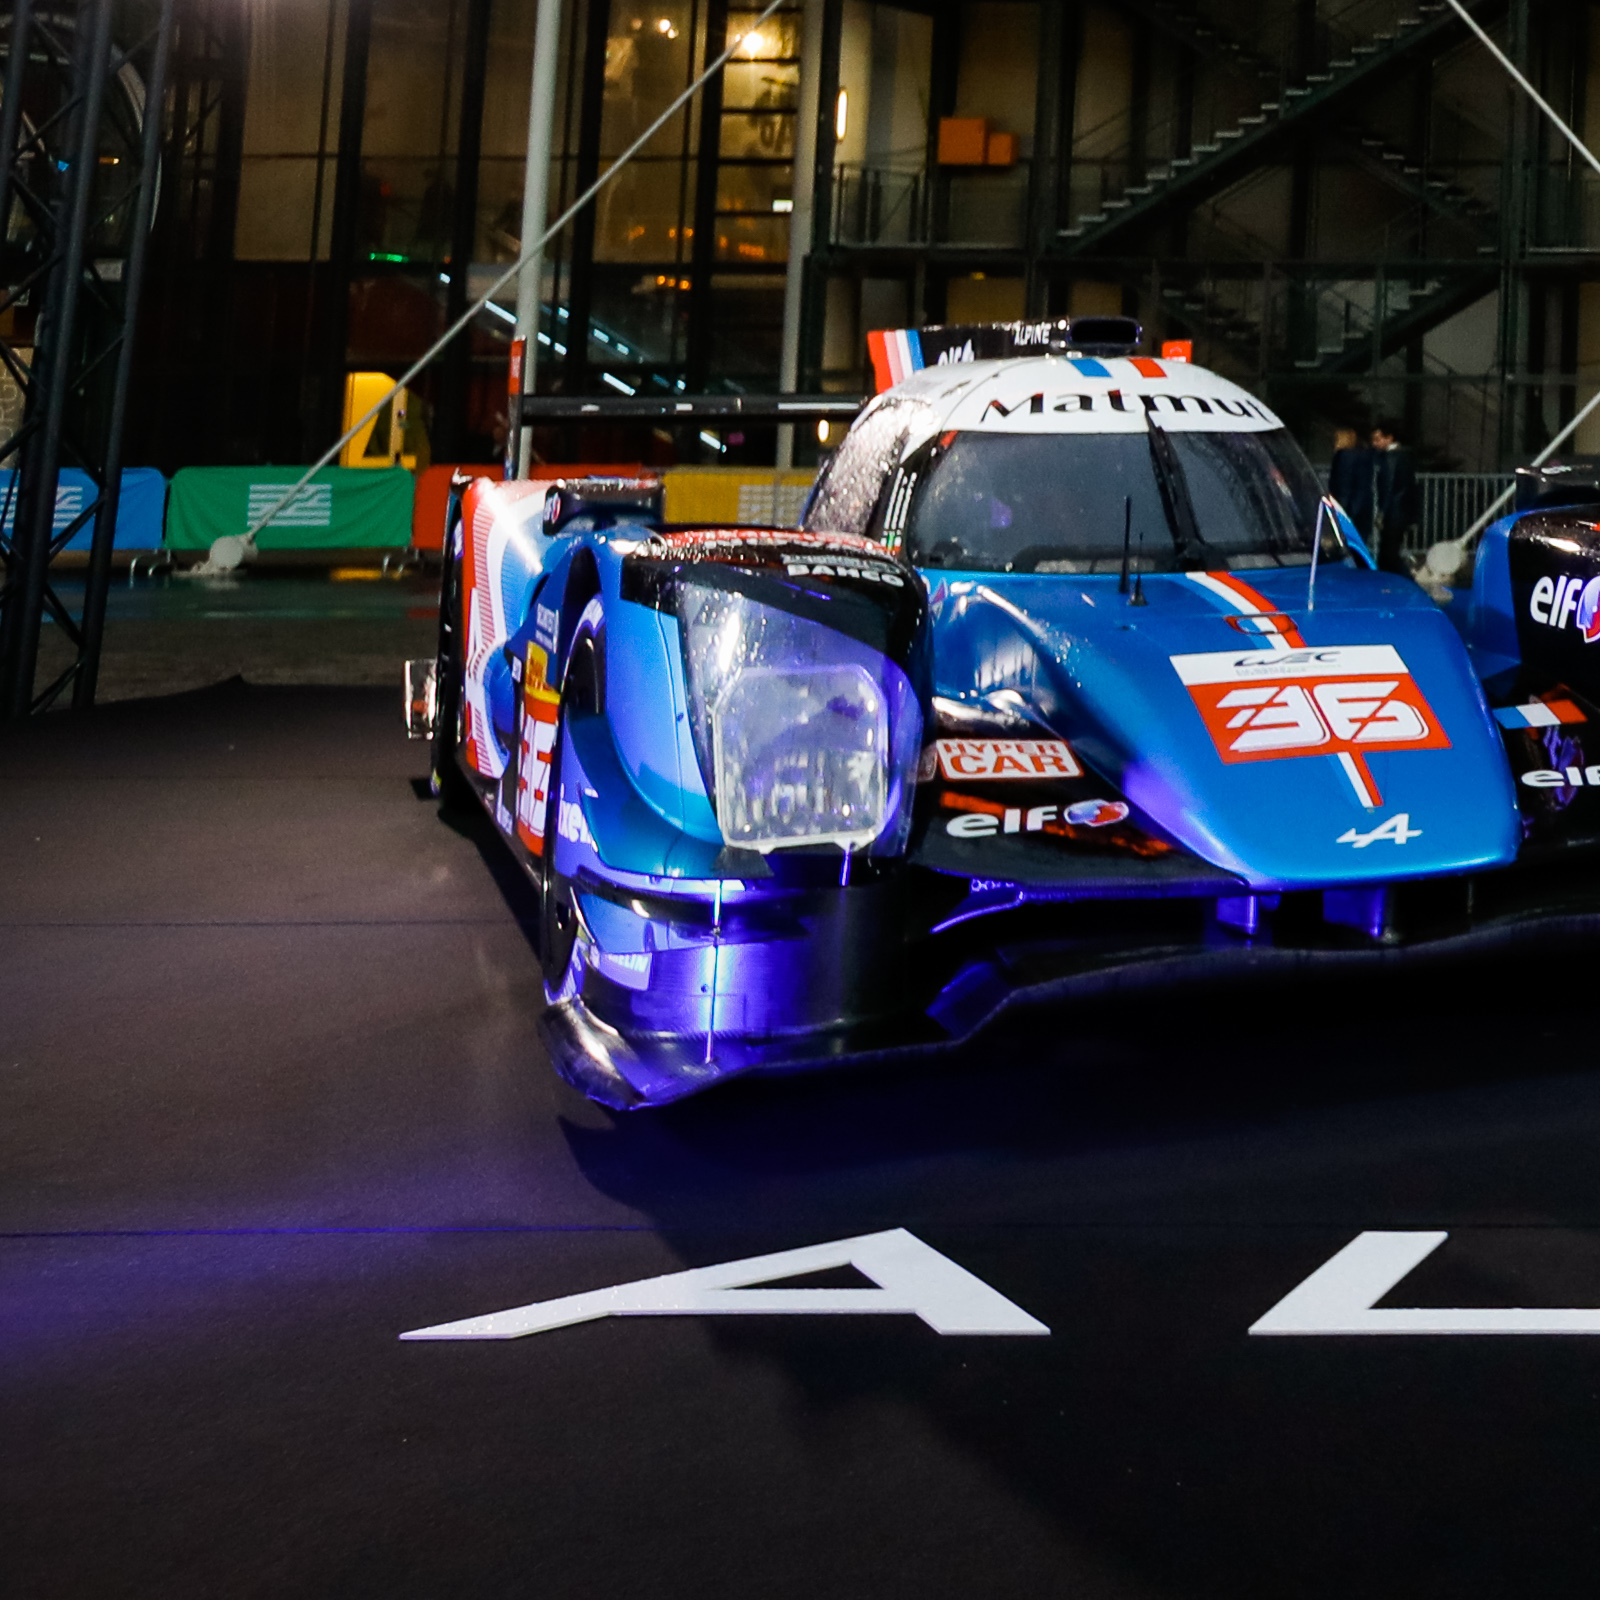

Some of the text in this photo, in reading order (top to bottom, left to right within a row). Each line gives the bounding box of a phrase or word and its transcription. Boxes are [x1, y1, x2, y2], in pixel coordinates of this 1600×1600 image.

[1013, 320, 1052, 346] ALPINE
[979, 387, 1274, 424] Matmut
[786, 563, 905, 588] BAHCO
[1529, 574, 1583, 630] elf
[1216, 681, 1430, 752] 36
[943, 741, 1060, 756] HYPER
[950, 755, 1069, 775] CAR
[945, 805, 1058, 839] elf
